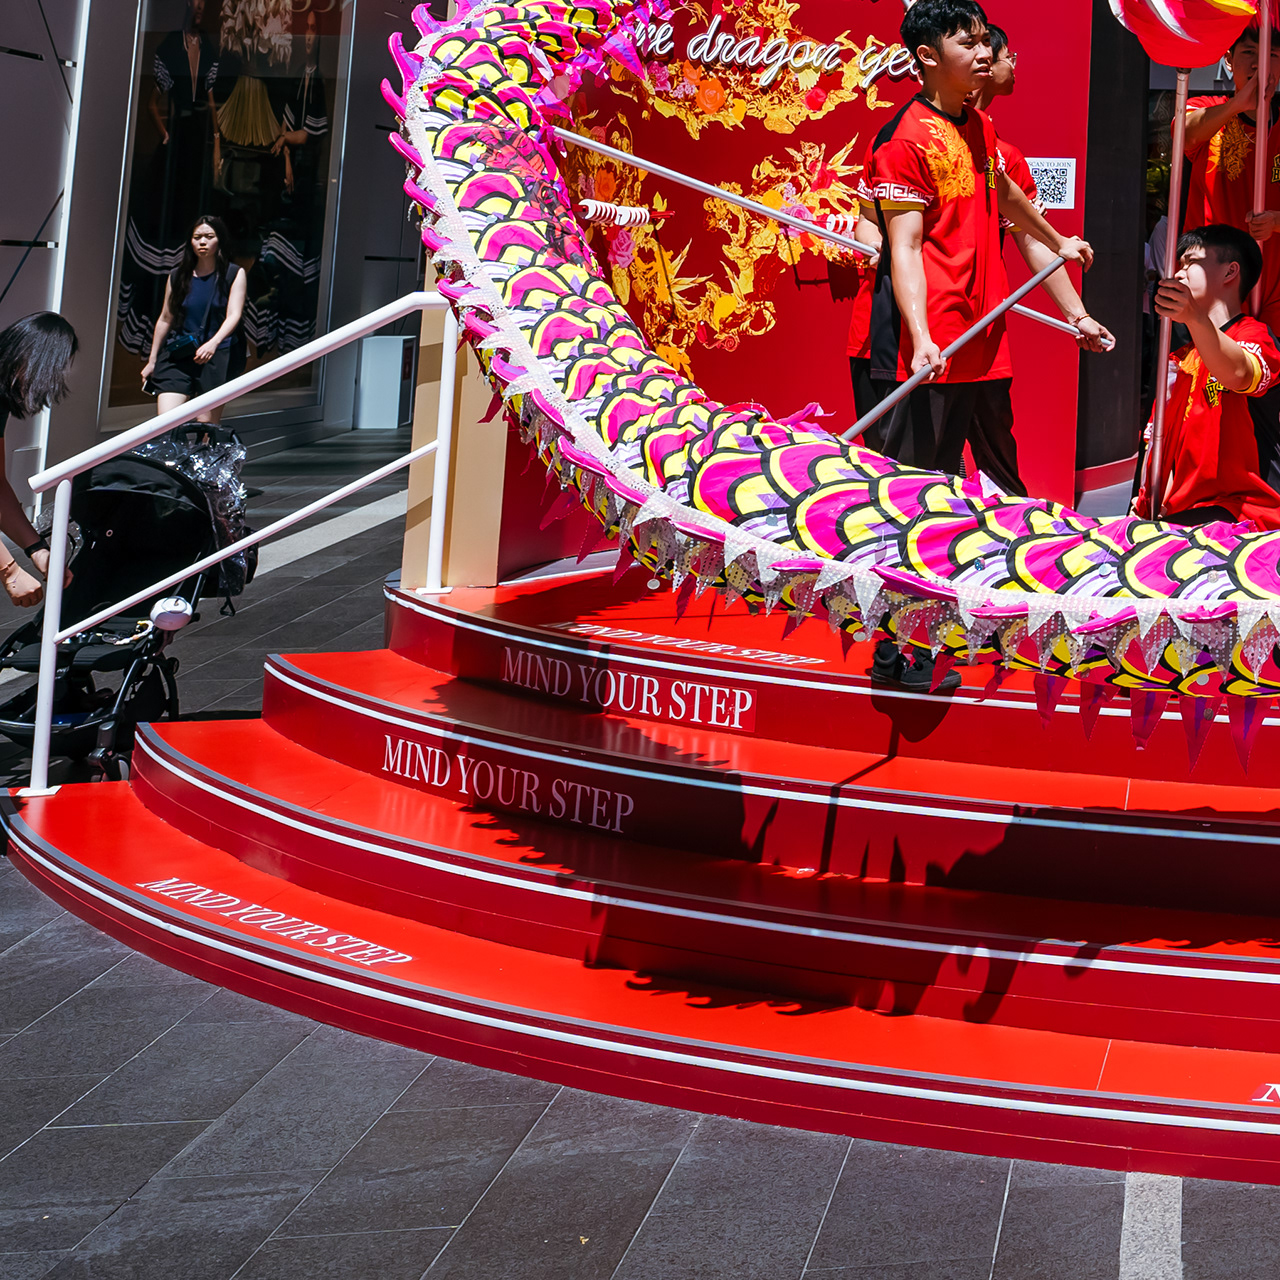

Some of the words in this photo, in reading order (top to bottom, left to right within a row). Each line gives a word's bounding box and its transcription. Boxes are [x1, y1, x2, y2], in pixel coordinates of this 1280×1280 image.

[688, 14, 842, 88] dragon
[502, 646, 571, 696] MIND
[577, 665, 662, 716] YOUR
[668, 680, 753, 729] STEP
[639, 634, 737, 654] YOUR
[727, 647, 826, 666] STEP
[381, 734, 450, 787] MIND
[456, 754, 542, 813] YOUR
[549, 778, 635, 834] STEP
[136, 877, 240, 910] MIND
[220, 903, 329, 940] YOUR
[305, 933, 413, 966] STEP
